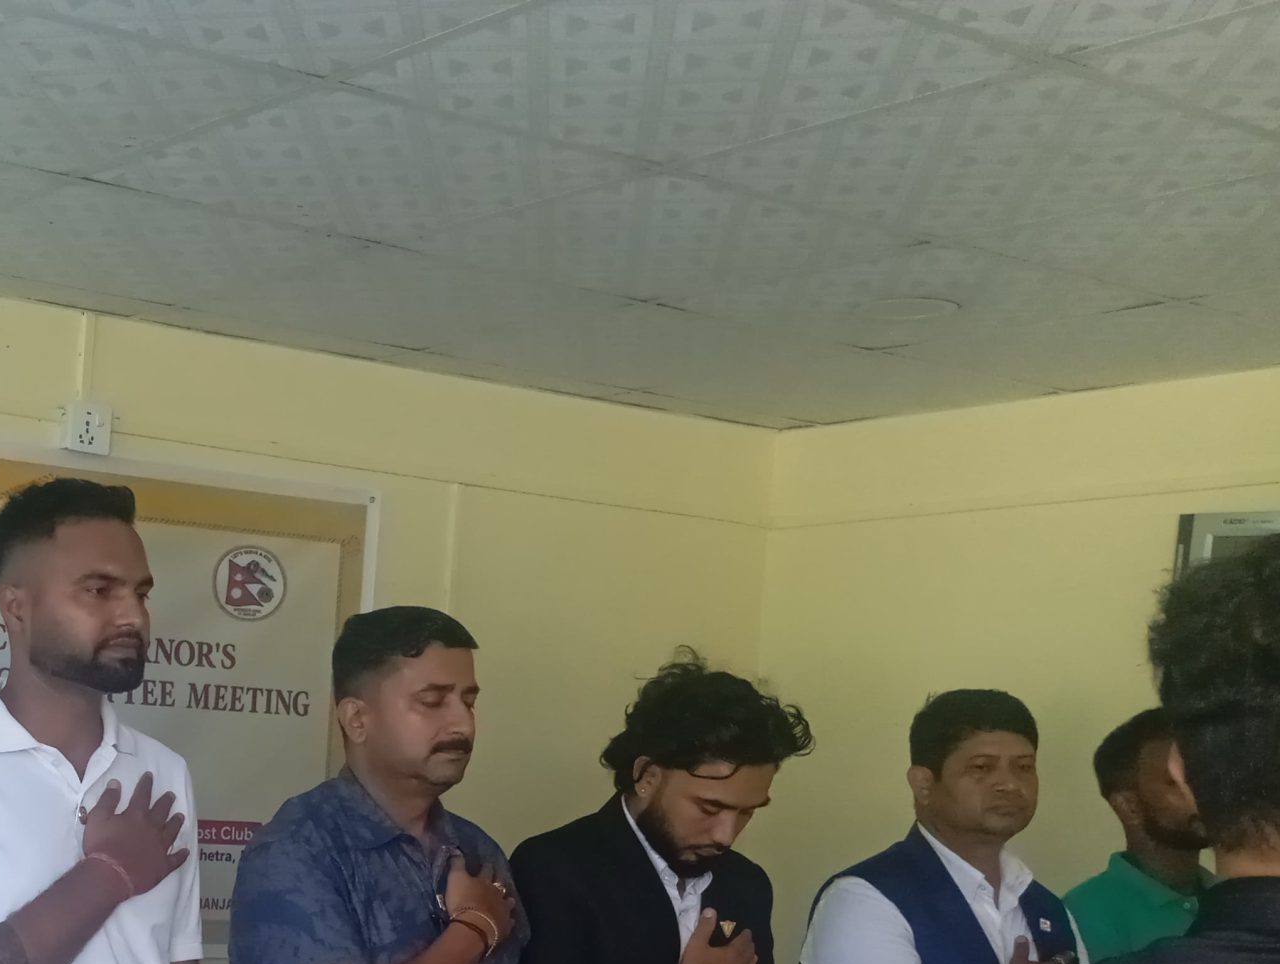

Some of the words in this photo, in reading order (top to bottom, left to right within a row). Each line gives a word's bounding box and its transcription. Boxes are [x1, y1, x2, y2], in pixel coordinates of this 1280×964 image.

[186, 683, 310, 717] MEETING
[221, 826, 253, 840] Club
[200, 848, 235, 863] hetra,
